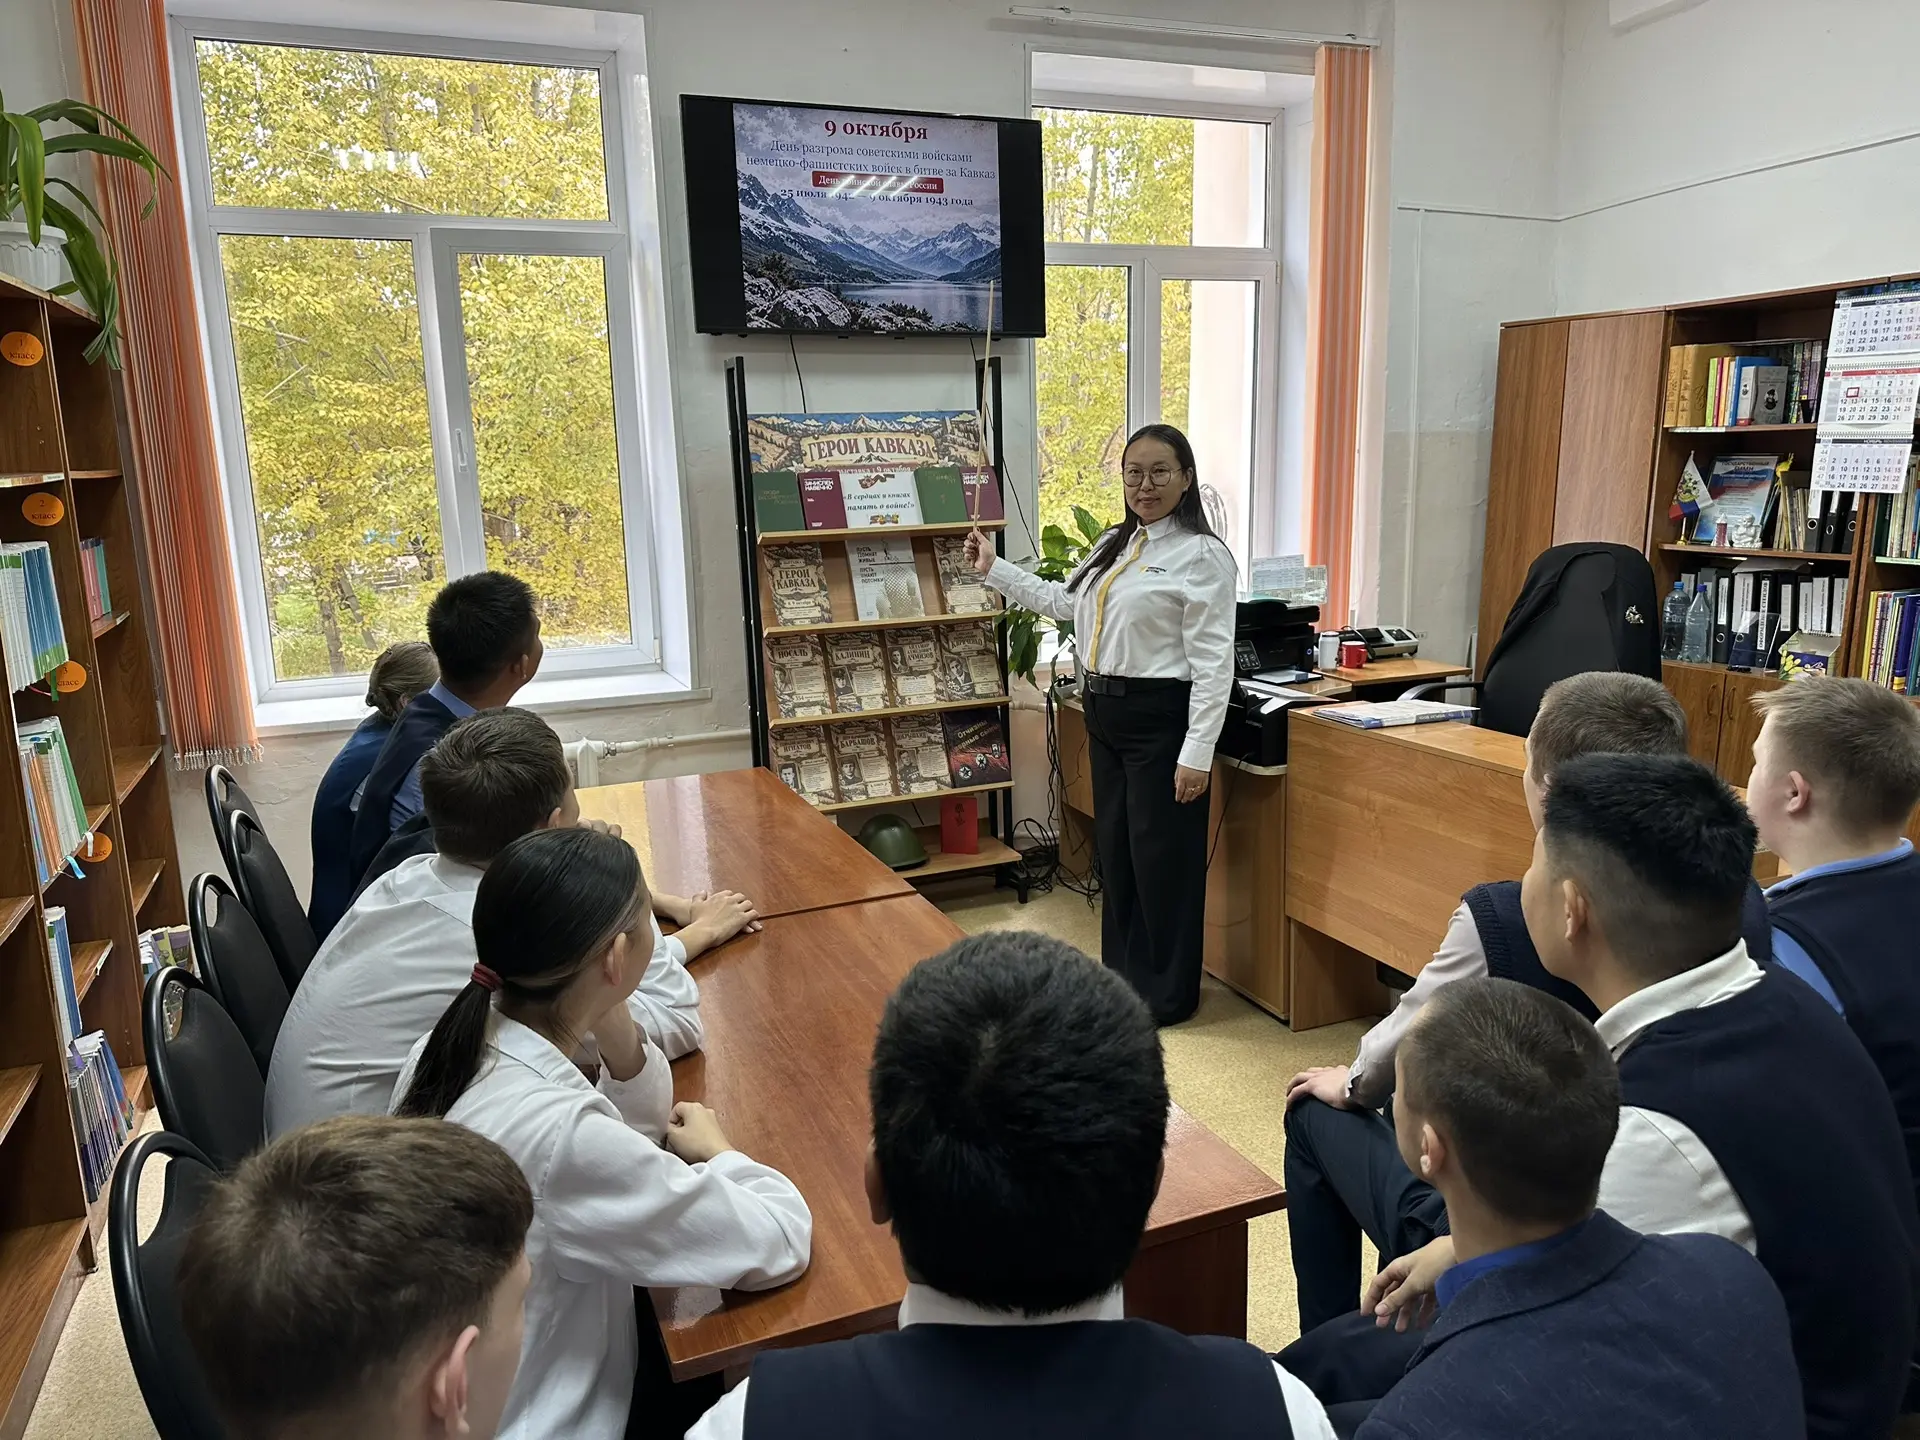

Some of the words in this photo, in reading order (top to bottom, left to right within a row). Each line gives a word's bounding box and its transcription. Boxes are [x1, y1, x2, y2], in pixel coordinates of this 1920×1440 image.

[824, 120, 837, 137] 9
[842, 120, 928, 143] октября
[770, 140, 800, 153] День
[802, 143, 854, 156] разгрома
[856, 147, 919, 160] советскими
[922, 149, 973, 163] войсками
[746, 156, 869, 172] немецко-фашистских
[871, 162, 903, 174] войск
[905, 166, 911, 174] в
[913, 164, 944, 176] битве
[945, 168, 957, 177] за
[960, 167, 996, 179] Кавказ
[818, 175, 841, 185] День
[909, 180, 938, 190] России
[780, 189, 794, 200] 25
[796, 190, 827, 199] июля
[878, 193, 922, 205] октября
[925, 196, 949, 206] 1943
[951, 197, 974, 207] года
[9, 352, 35, 360] класс
[807, 438, 860, 462] ГЕРОИ
[864, 437, 936, 460] КАВКАЗА
[853, 492, 881, 501] сердцах
[40, 499, 45, 507] 2
[847, 503, 878, 511] память
[31, 512, 56, 520] класс
[778, 568, 810, 579] ГЕРОИ
[775, 578, 816, 590] КАВКАЗА
[778, 648, 808, 659] НОСАЛЬ
[835, 649, 870, 661] КАЛИНИН
[63, 666, 68, 675] 3
[783, 744, 812, 752] ИГНАТОВ
[840, 737, 876, 749] БАРБАШОВ
